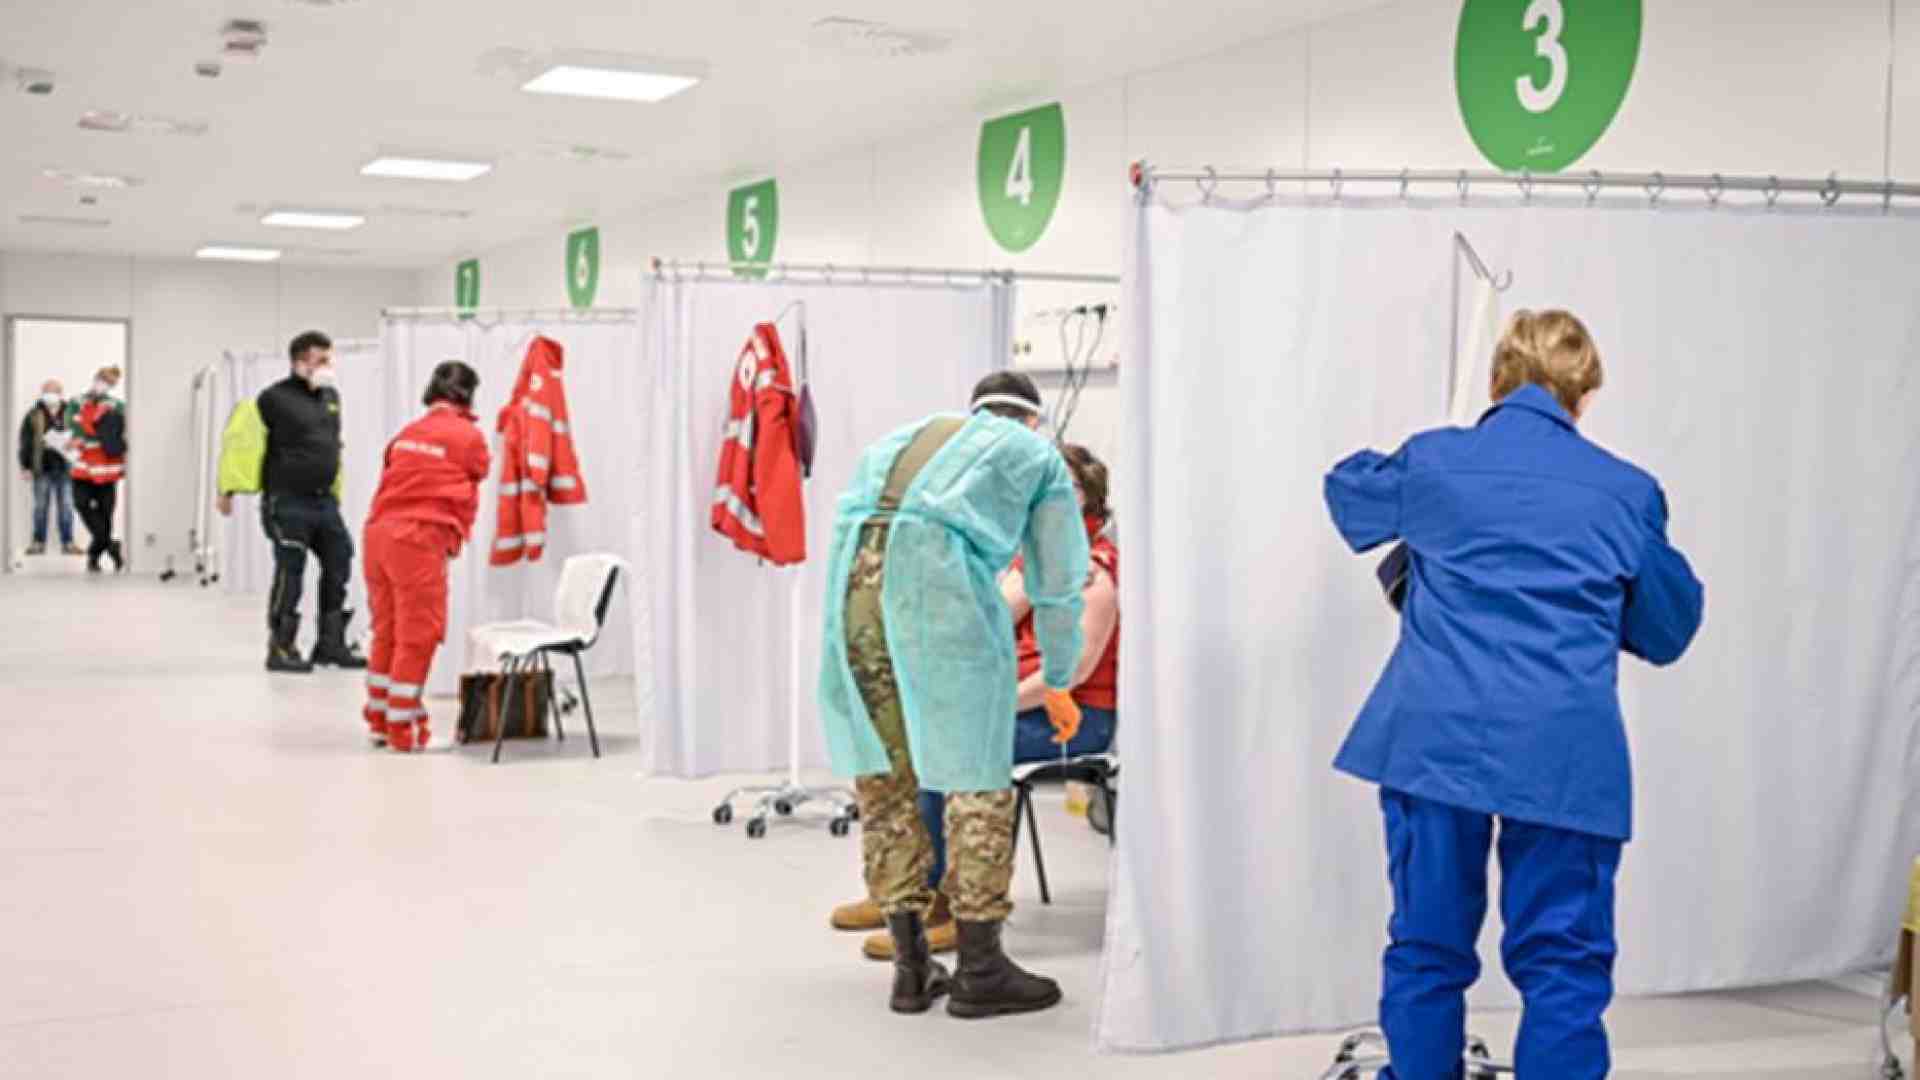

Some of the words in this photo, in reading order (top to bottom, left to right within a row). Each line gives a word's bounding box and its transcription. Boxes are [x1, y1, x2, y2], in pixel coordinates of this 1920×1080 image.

[1516, 0, 1568, 113] 3
[1005, 125, 1033, 207] 4
[575, 238, 590, 289] 6
[743, 196, 759, 259] 5
